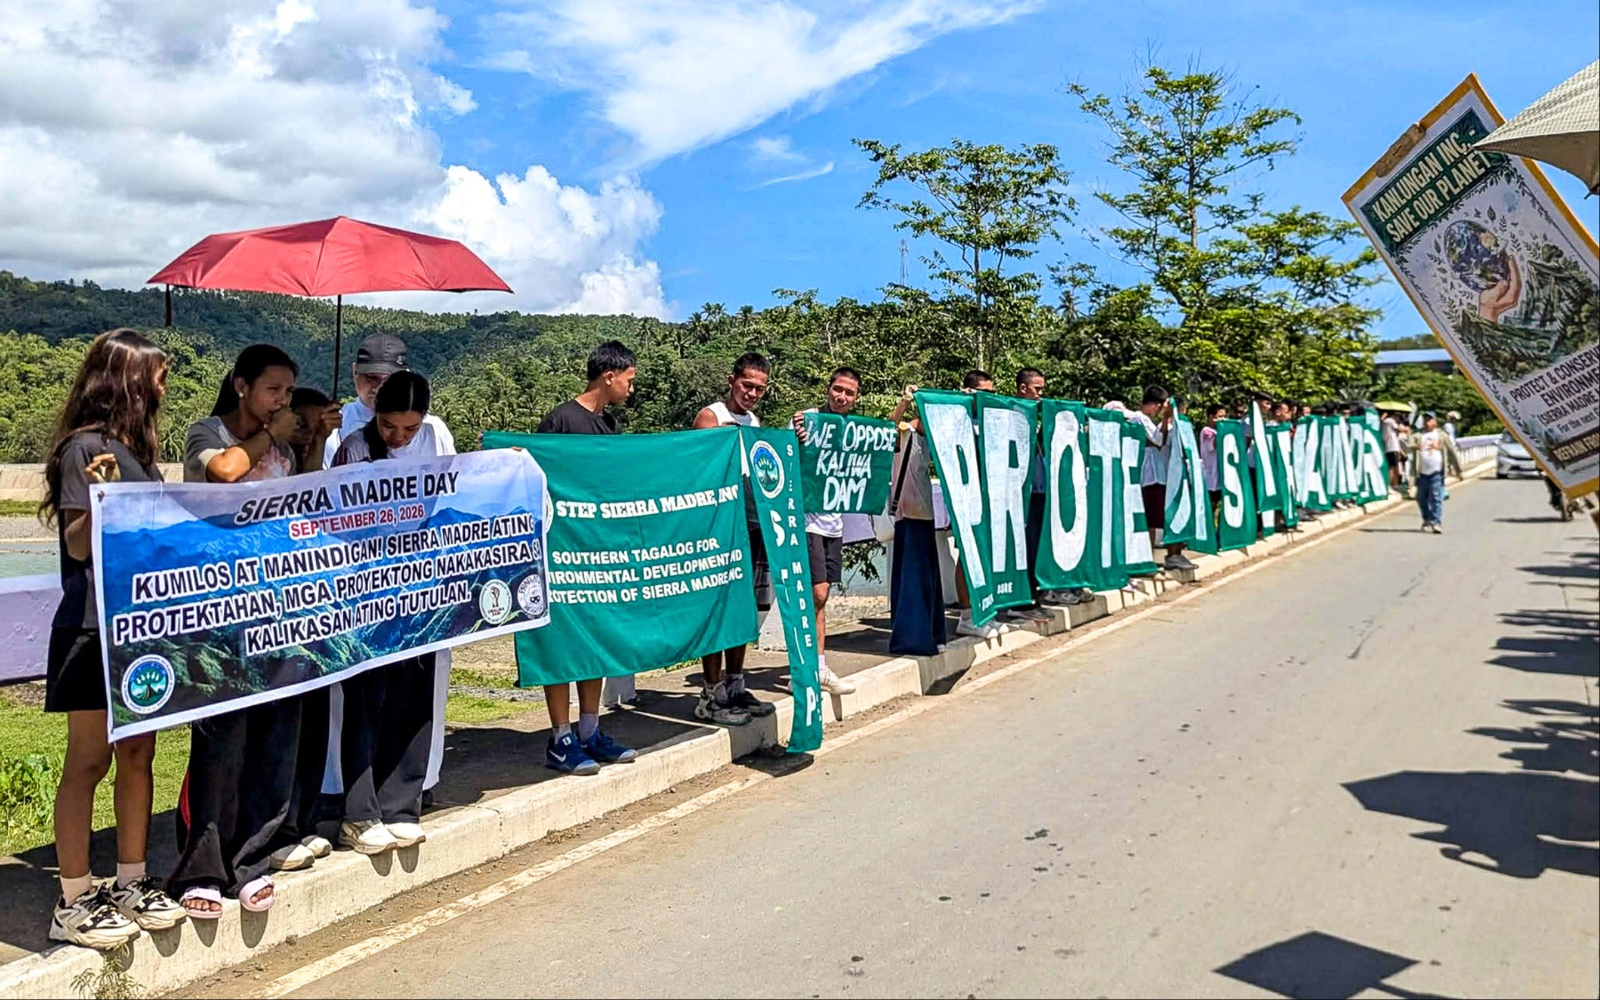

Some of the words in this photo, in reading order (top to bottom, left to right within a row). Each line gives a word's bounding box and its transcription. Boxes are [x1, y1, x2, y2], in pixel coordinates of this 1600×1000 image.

[1372, 152, 1443, 222] KANLUNGAN
[1386, 207, 1420, 242] SAVE
[1412, 188, 1444, 220] OUR
[1435, 150, 1491, 200] PLANET
[1509, 375, 1549, 403] PROTECT
[1547, 371, 1559, 384] &
[1566, 391, 1598, 413] MADRE
[804, 420, 836, 448] WE
[842, 421, 898, 452] OPPOSE
[1568, 419, 1581, 429] the
[816, 449, 871, 479] KALIWA
[236, 487, 334, 523] SIERRA
[339, 476, 418, 508] MADRE
[423, 471, 459, 497] DAY
[556, 500, 597, 518] STEP
[600, 499, 659, 519] SIERRA
[660, 490, 718, 513] MADRE,
[823, 476, 867, 511] DAM
[290, 511, 376, 537] SEPTEMBER
[379, 509, 397, 525] 26,
[400, 504, 424, 521] 2026
[135, 564, 230, 600] KUMILOS
[236, 560, 258, 584] AT
[264, 537, 382, 579] MANINDIGAN!
[387, 531, 439, 556] SIERRA
[441, 520, 489, 547] MADRE
[552, 550, 629, 565] SOUTHERN
[632, 541, 694, 562] TAGALOG
[696, 537, 720, 553] FOR
[549, 569, 639, 584] IRONMENTAL
[643, 552, 730, 581] DEVELOPMENT
[116, 592, 282, 642] PROTEKTAHAN,
[284, 582, 332, 610] MGA
[336, 561, 432, 599] PROYEKTONG
[437, 542, 531, 577] NAKAKASIRA
[549, 588, 618, 604] OTECTION
[620, 588, 638, 602] OF
[642, 581, 689, 600] SIERRA
[792, 561, 812, 648] MADRE
[246, 608, 352, 653] KALIKASAN
[355, 598, 394, 625] ATING
[399, 581, 471, 614] TUTULAN.
